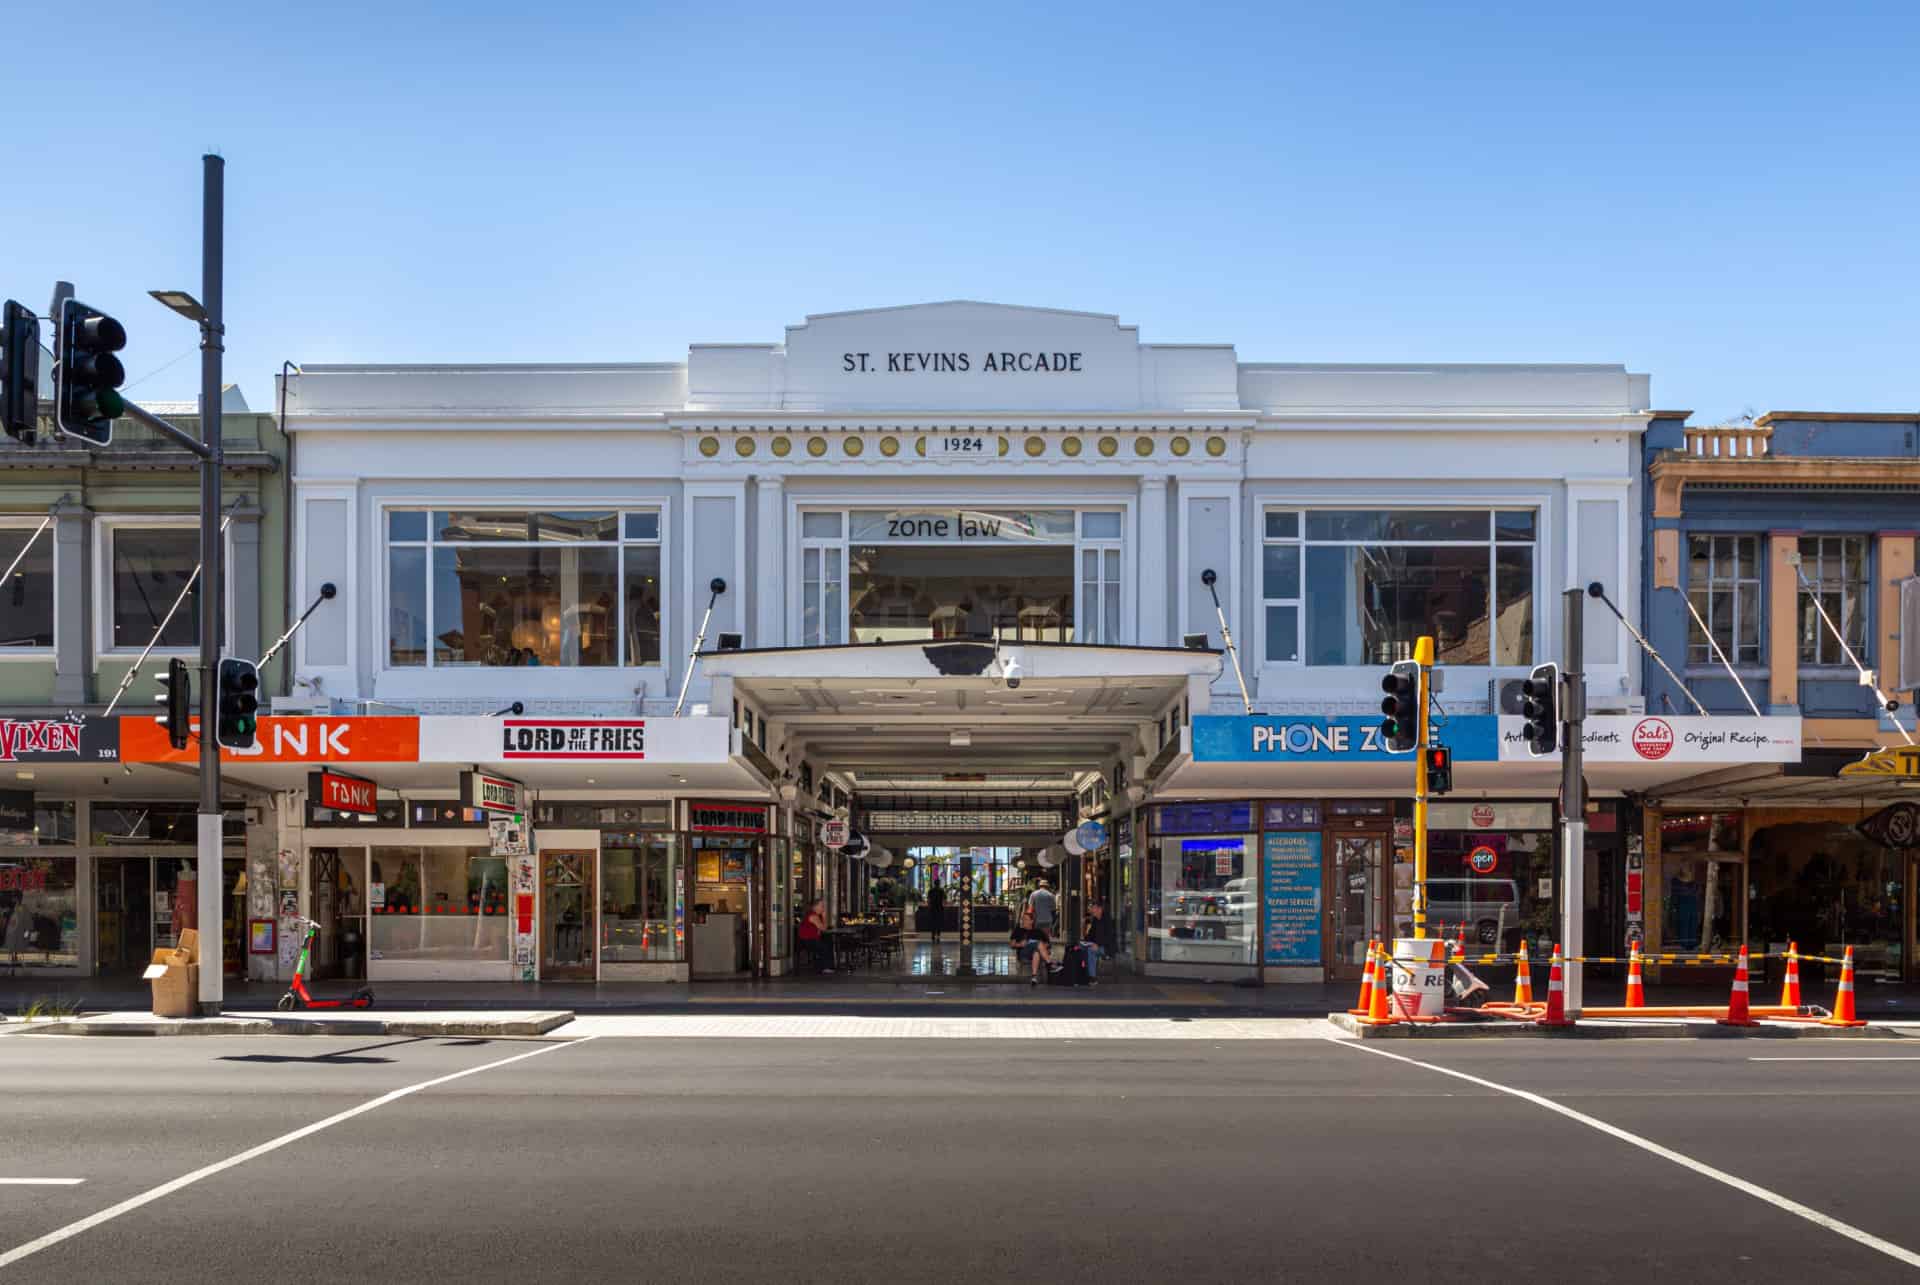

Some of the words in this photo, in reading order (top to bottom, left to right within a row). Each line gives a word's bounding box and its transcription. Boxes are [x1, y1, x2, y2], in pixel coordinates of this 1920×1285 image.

[843, 352, 875, 372] ST.
[888, 352, 970, 372] KEVINS
[984, 352, 1082, 372] ARCADE
[943, 438, 983, 452] 1924
[887, 519, 948, 537] zone
[957, 513, 1001, 537] law
[503, 728, 565, 751] LORD
[571, 728, 585, 740] OF
[589, 728, 644, 751] FRIES
[1252, 723, 1349, 753] PHONE
[1360, 725, 1440, 751] ZE
[1684, 731, 1725, 750] Original
[98, 749, 117, 758] 191
[568, 740, 587, 751] THE
